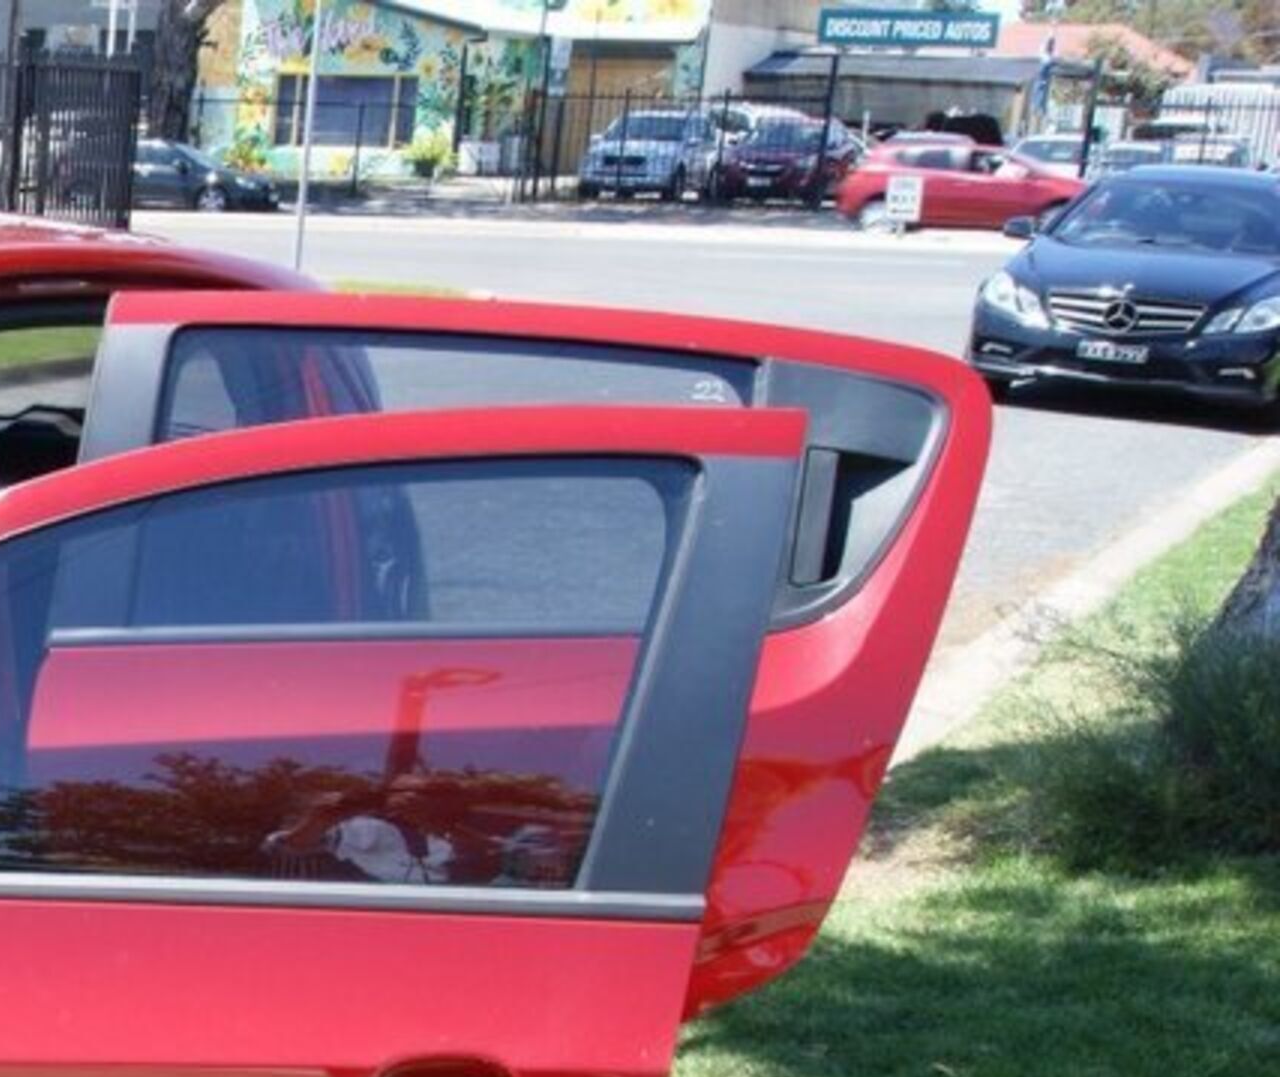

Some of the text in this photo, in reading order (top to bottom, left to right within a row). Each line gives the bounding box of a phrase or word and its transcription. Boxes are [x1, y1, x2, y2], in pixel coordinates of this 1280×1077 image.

[825, 17, 991, 42] DISCOUNT PRICED AUTOS
